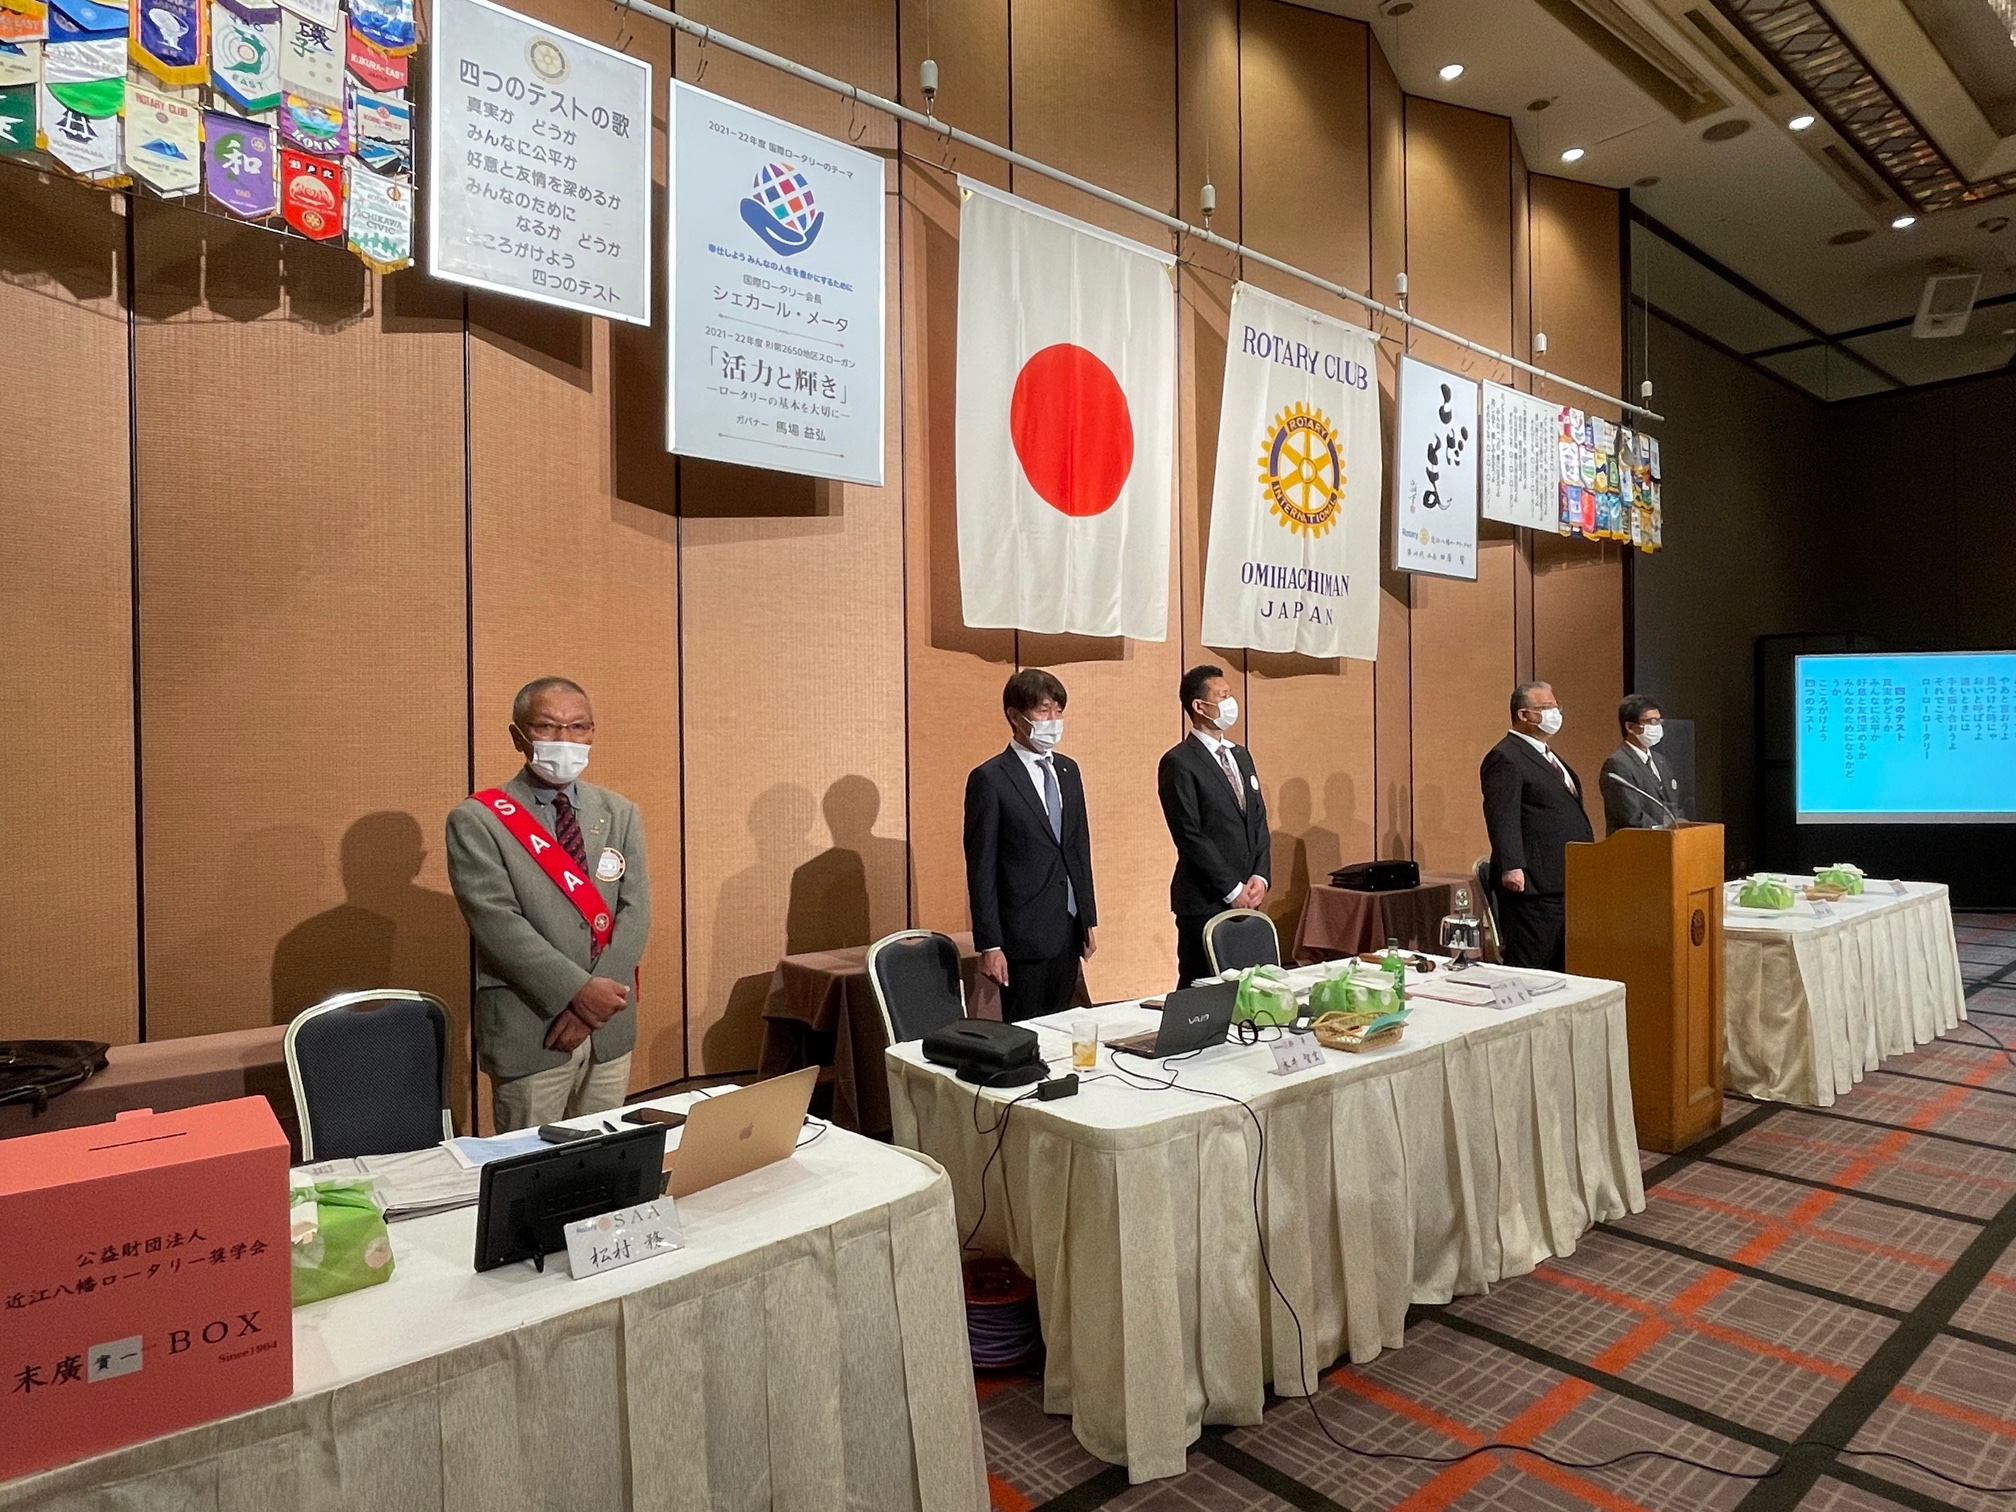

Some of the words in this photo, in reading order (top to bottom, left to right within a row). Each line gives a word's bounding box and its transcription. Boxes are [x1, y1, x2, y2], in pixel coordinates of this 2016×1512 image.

[232, 73, 263, 90] EAST
[460, 58, 630, 139] 四つのテストの歌
[135, 92, 165, 110] ROTARY
[168, 103, 188, 118] CLUB
[467, 95, 515, 124] 真実か
[532, 119, 577, 146] どうか
[222, 139, 263, 176] 和
[292, 129, 341, 152] KONAN
[467, 123, 578, 171] みんなに公平か
[466, 177, 577, 222] みんなのために
[467, 150, 622, 211] 好意と友情を深めるか
[366, 220, 396, 236] CIVIC
[515, 216, 562, 241] なるか
[578, 232, 622, 258] どうか
[532, 268, 621, 303] 四つのテスト
[713, 285, 849, 332] シェカール・メータ
[1242, 325, 1321, 375] ROTARY
[1324, 355, 1368, 390] CLUB
[1288, 416, 1328, 438] ROTARY
[1241, 561, 1350, 597] OMIHACHIMAN
[1260, 600, 1333, 626] JAPAN
[1804, 678, 1816, 733] 四つのテスト
[1895, 687, 1906, 742] 四つのテスト
[613, 1204, 660, 1228] SAA
[76, 1228, 207, 1268] 公益財団法人
[590, 1239, 631, 1268] 松村
[168, 1311, 262, 1356] BOX
